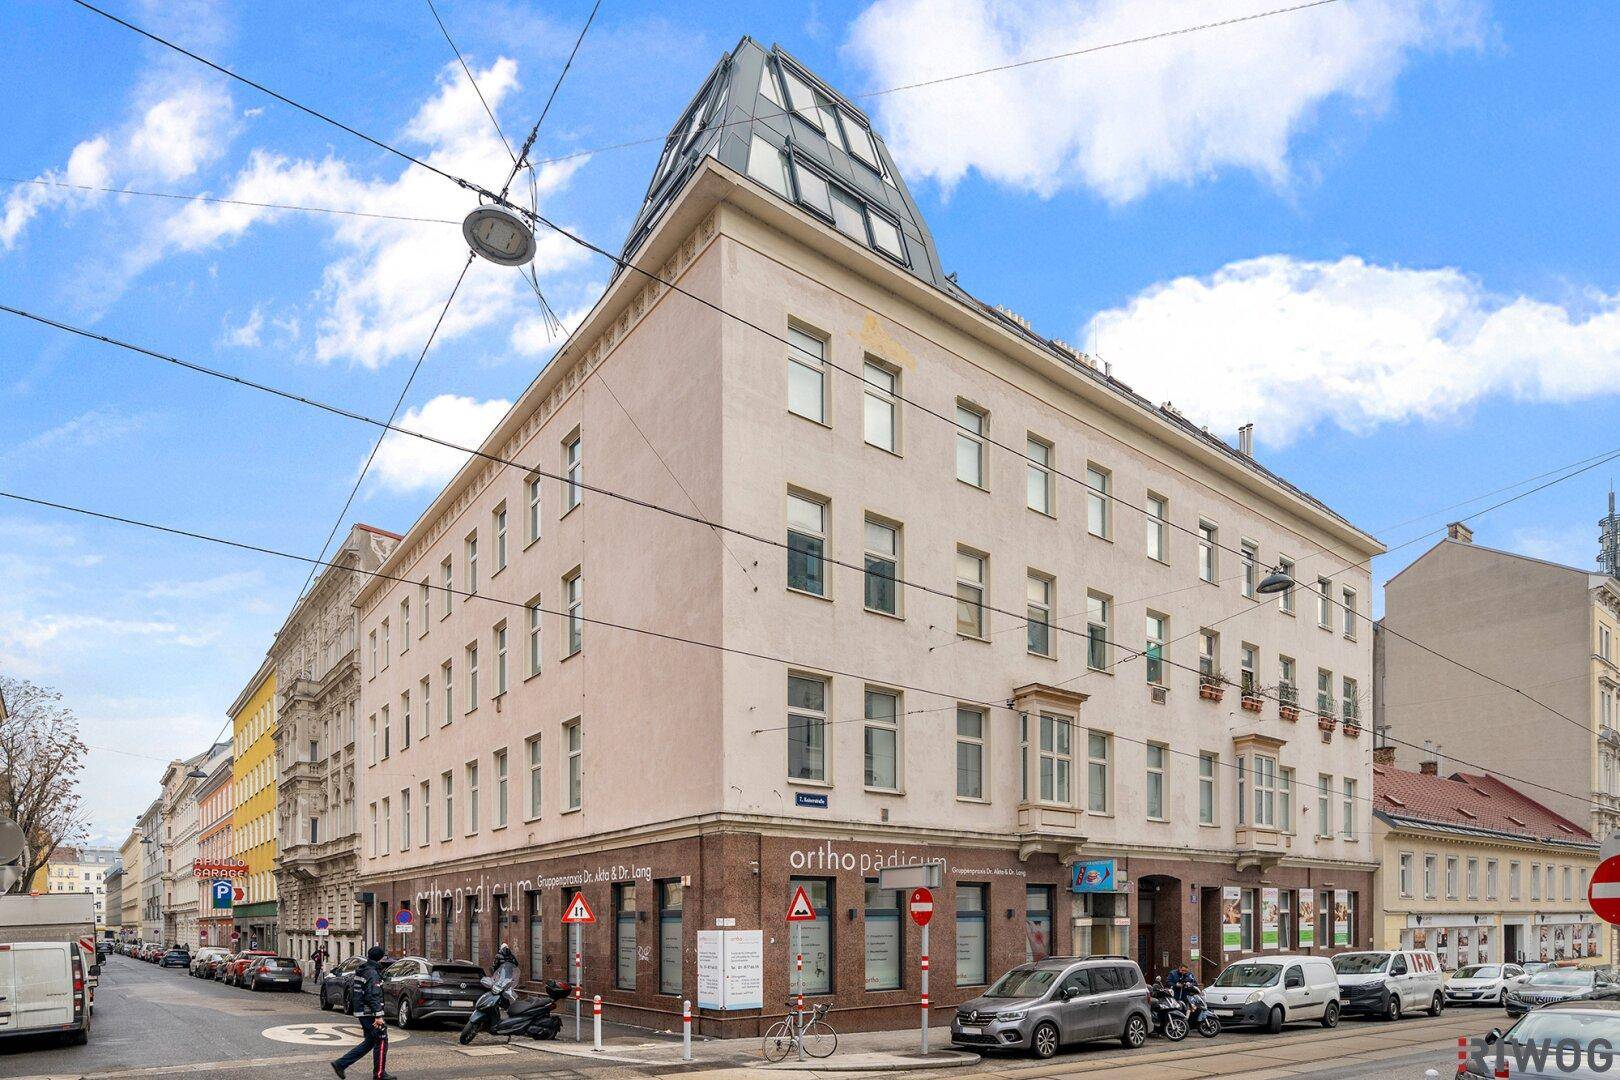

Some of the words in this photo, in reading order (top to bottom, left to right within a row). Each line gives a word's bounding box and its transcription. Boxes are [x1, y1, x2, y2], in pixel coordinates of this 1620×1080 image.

[194, 857, 245, 867] APOLLO
[193, 868, 244, 879] GARAGE
[537, 873, 583, 890] Gruppenpraxis
[584, 869, 594, 883] Dr.
[611, 866, 618, 880] &
[620, 865, 630, 879] Dr.
[631, 864, 652, 881] Lang
[217, 886, 230, 899] P
